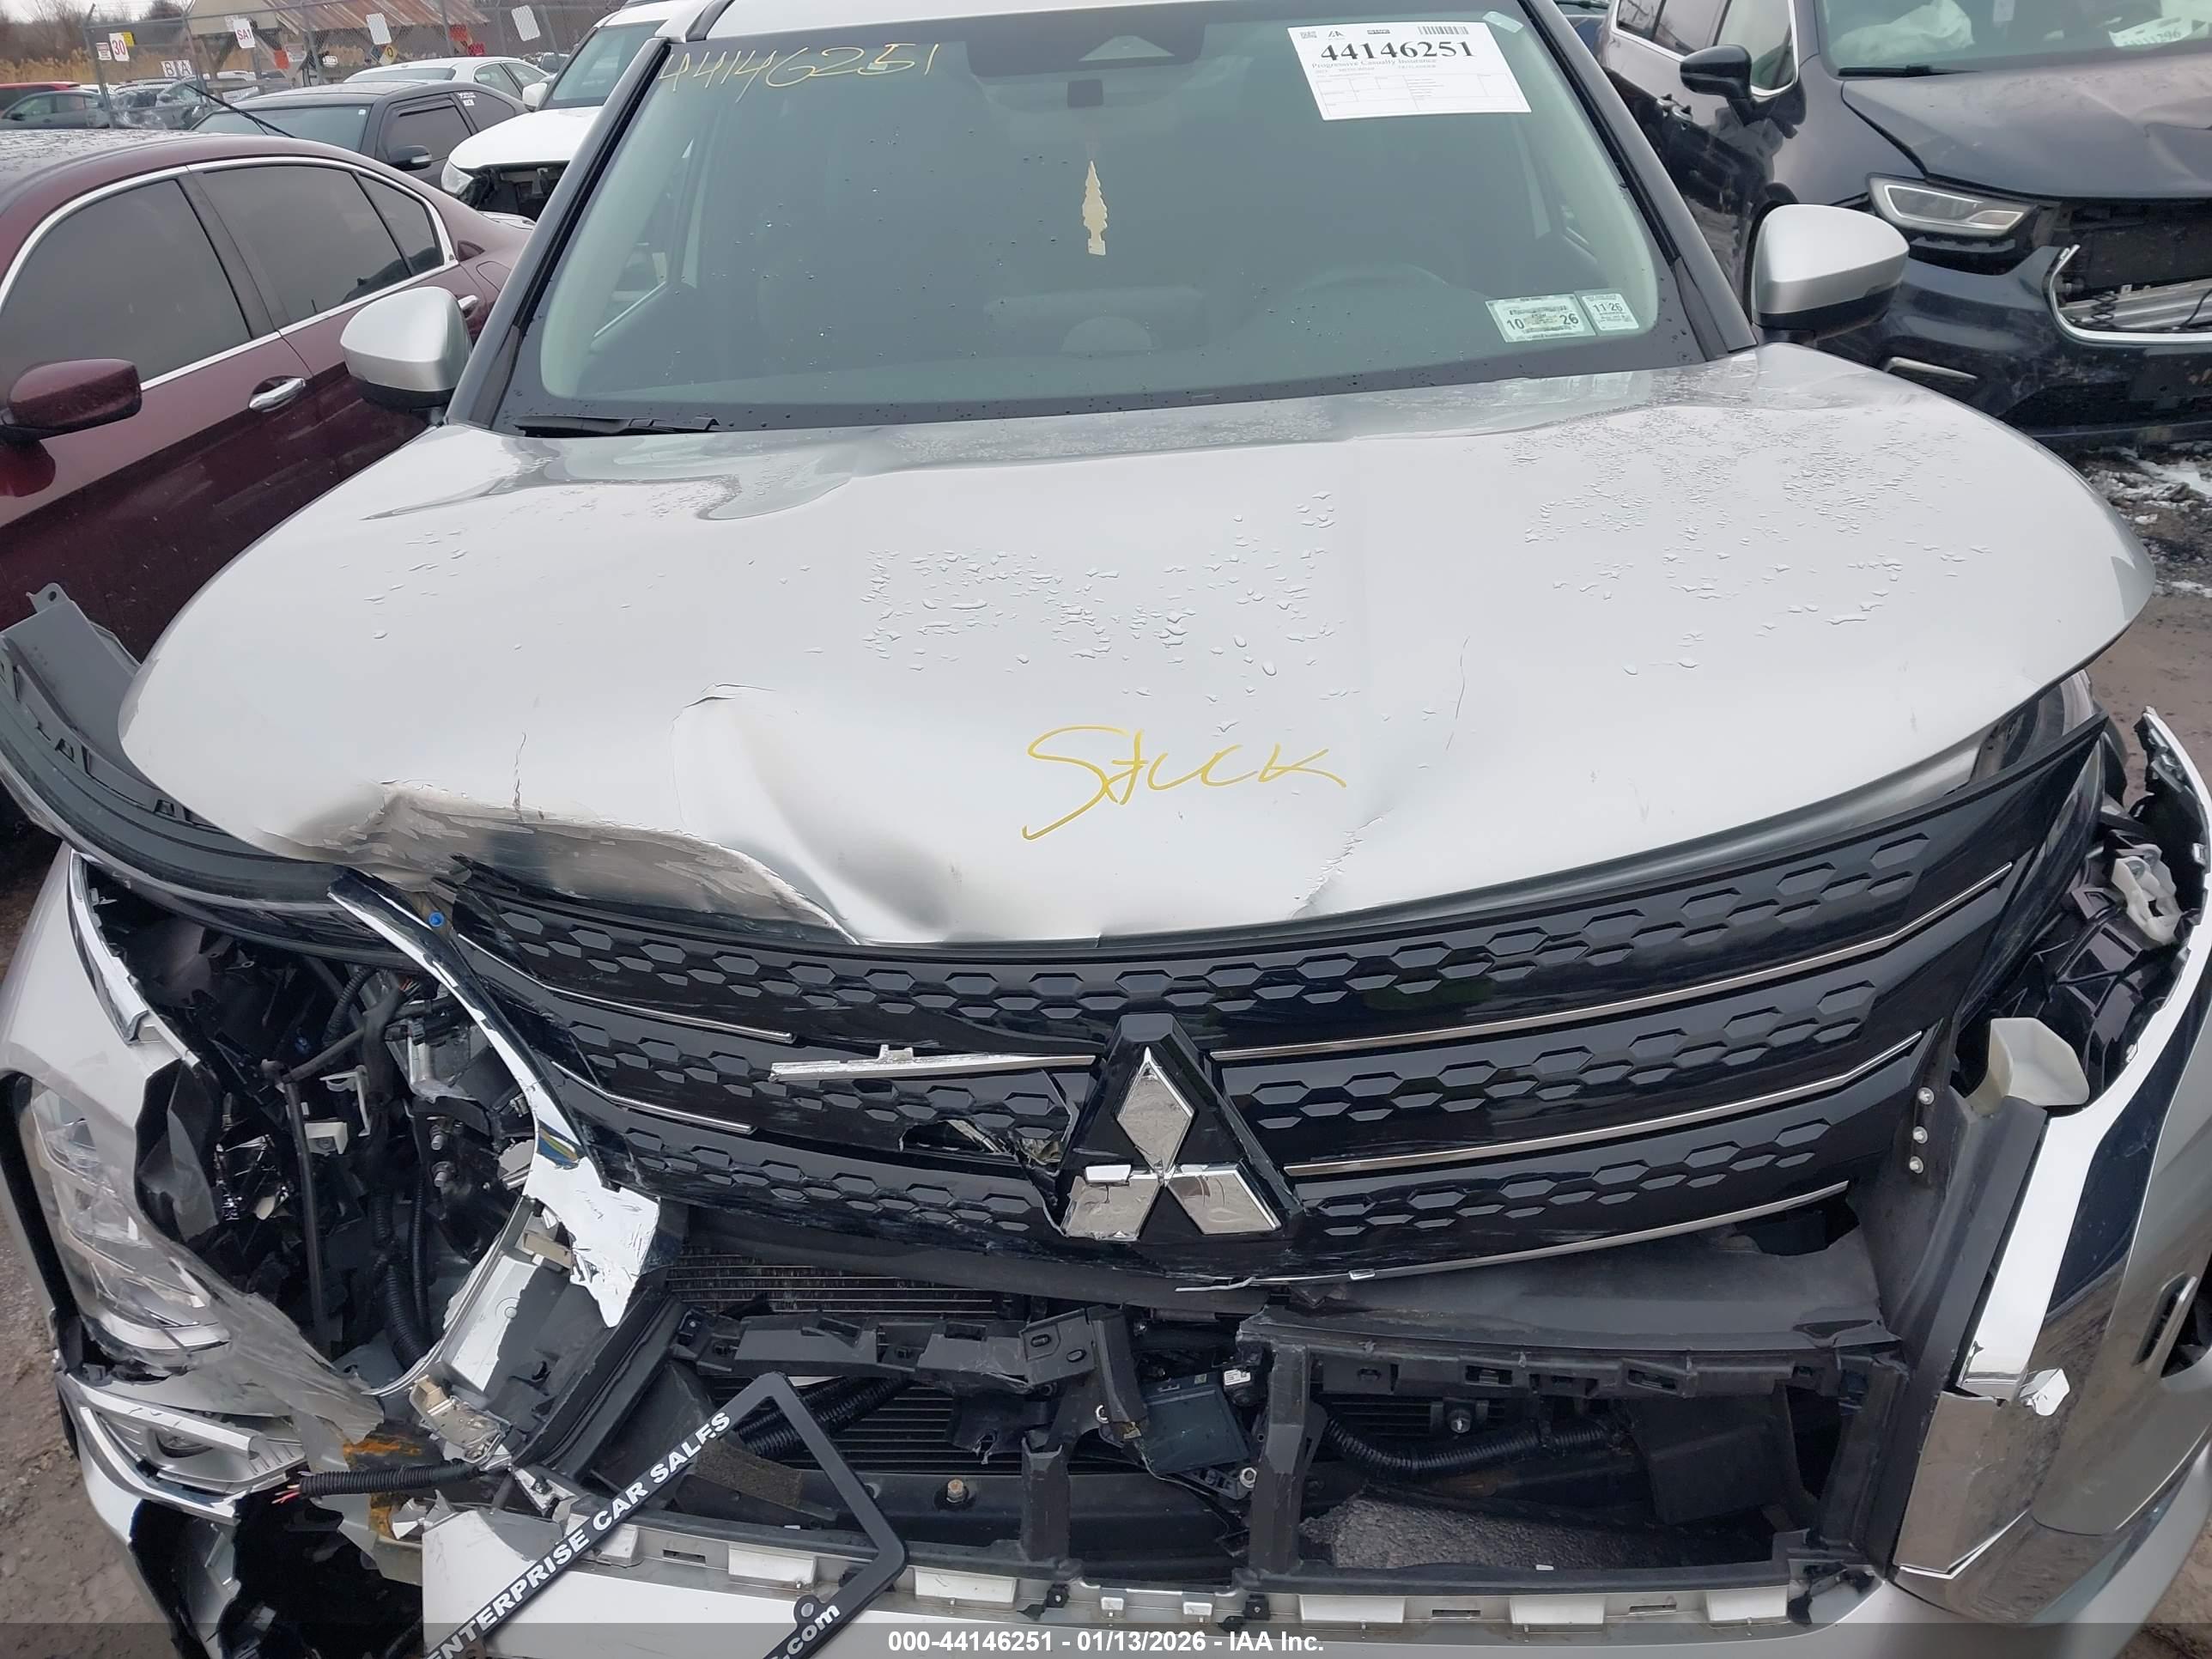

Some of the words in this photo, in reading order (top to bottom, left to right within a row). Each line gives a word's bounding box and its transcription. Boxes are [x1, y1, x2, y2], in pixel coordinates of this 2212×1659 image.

[112, 40, 126, 56] 30
[1321, 40, 1475, 61] 44146251
[659, 43, 940, 104] 44146251
[1592, 303, 1607, 313] 11
[1608, 302, 1623, 312] 26
[1506, 318, 1525, 331] 10
[1559, 313, 1579, 325] 26
[592, 1481, 649, 1531] CAR
[649, 1411, 732, 1484] SALES
